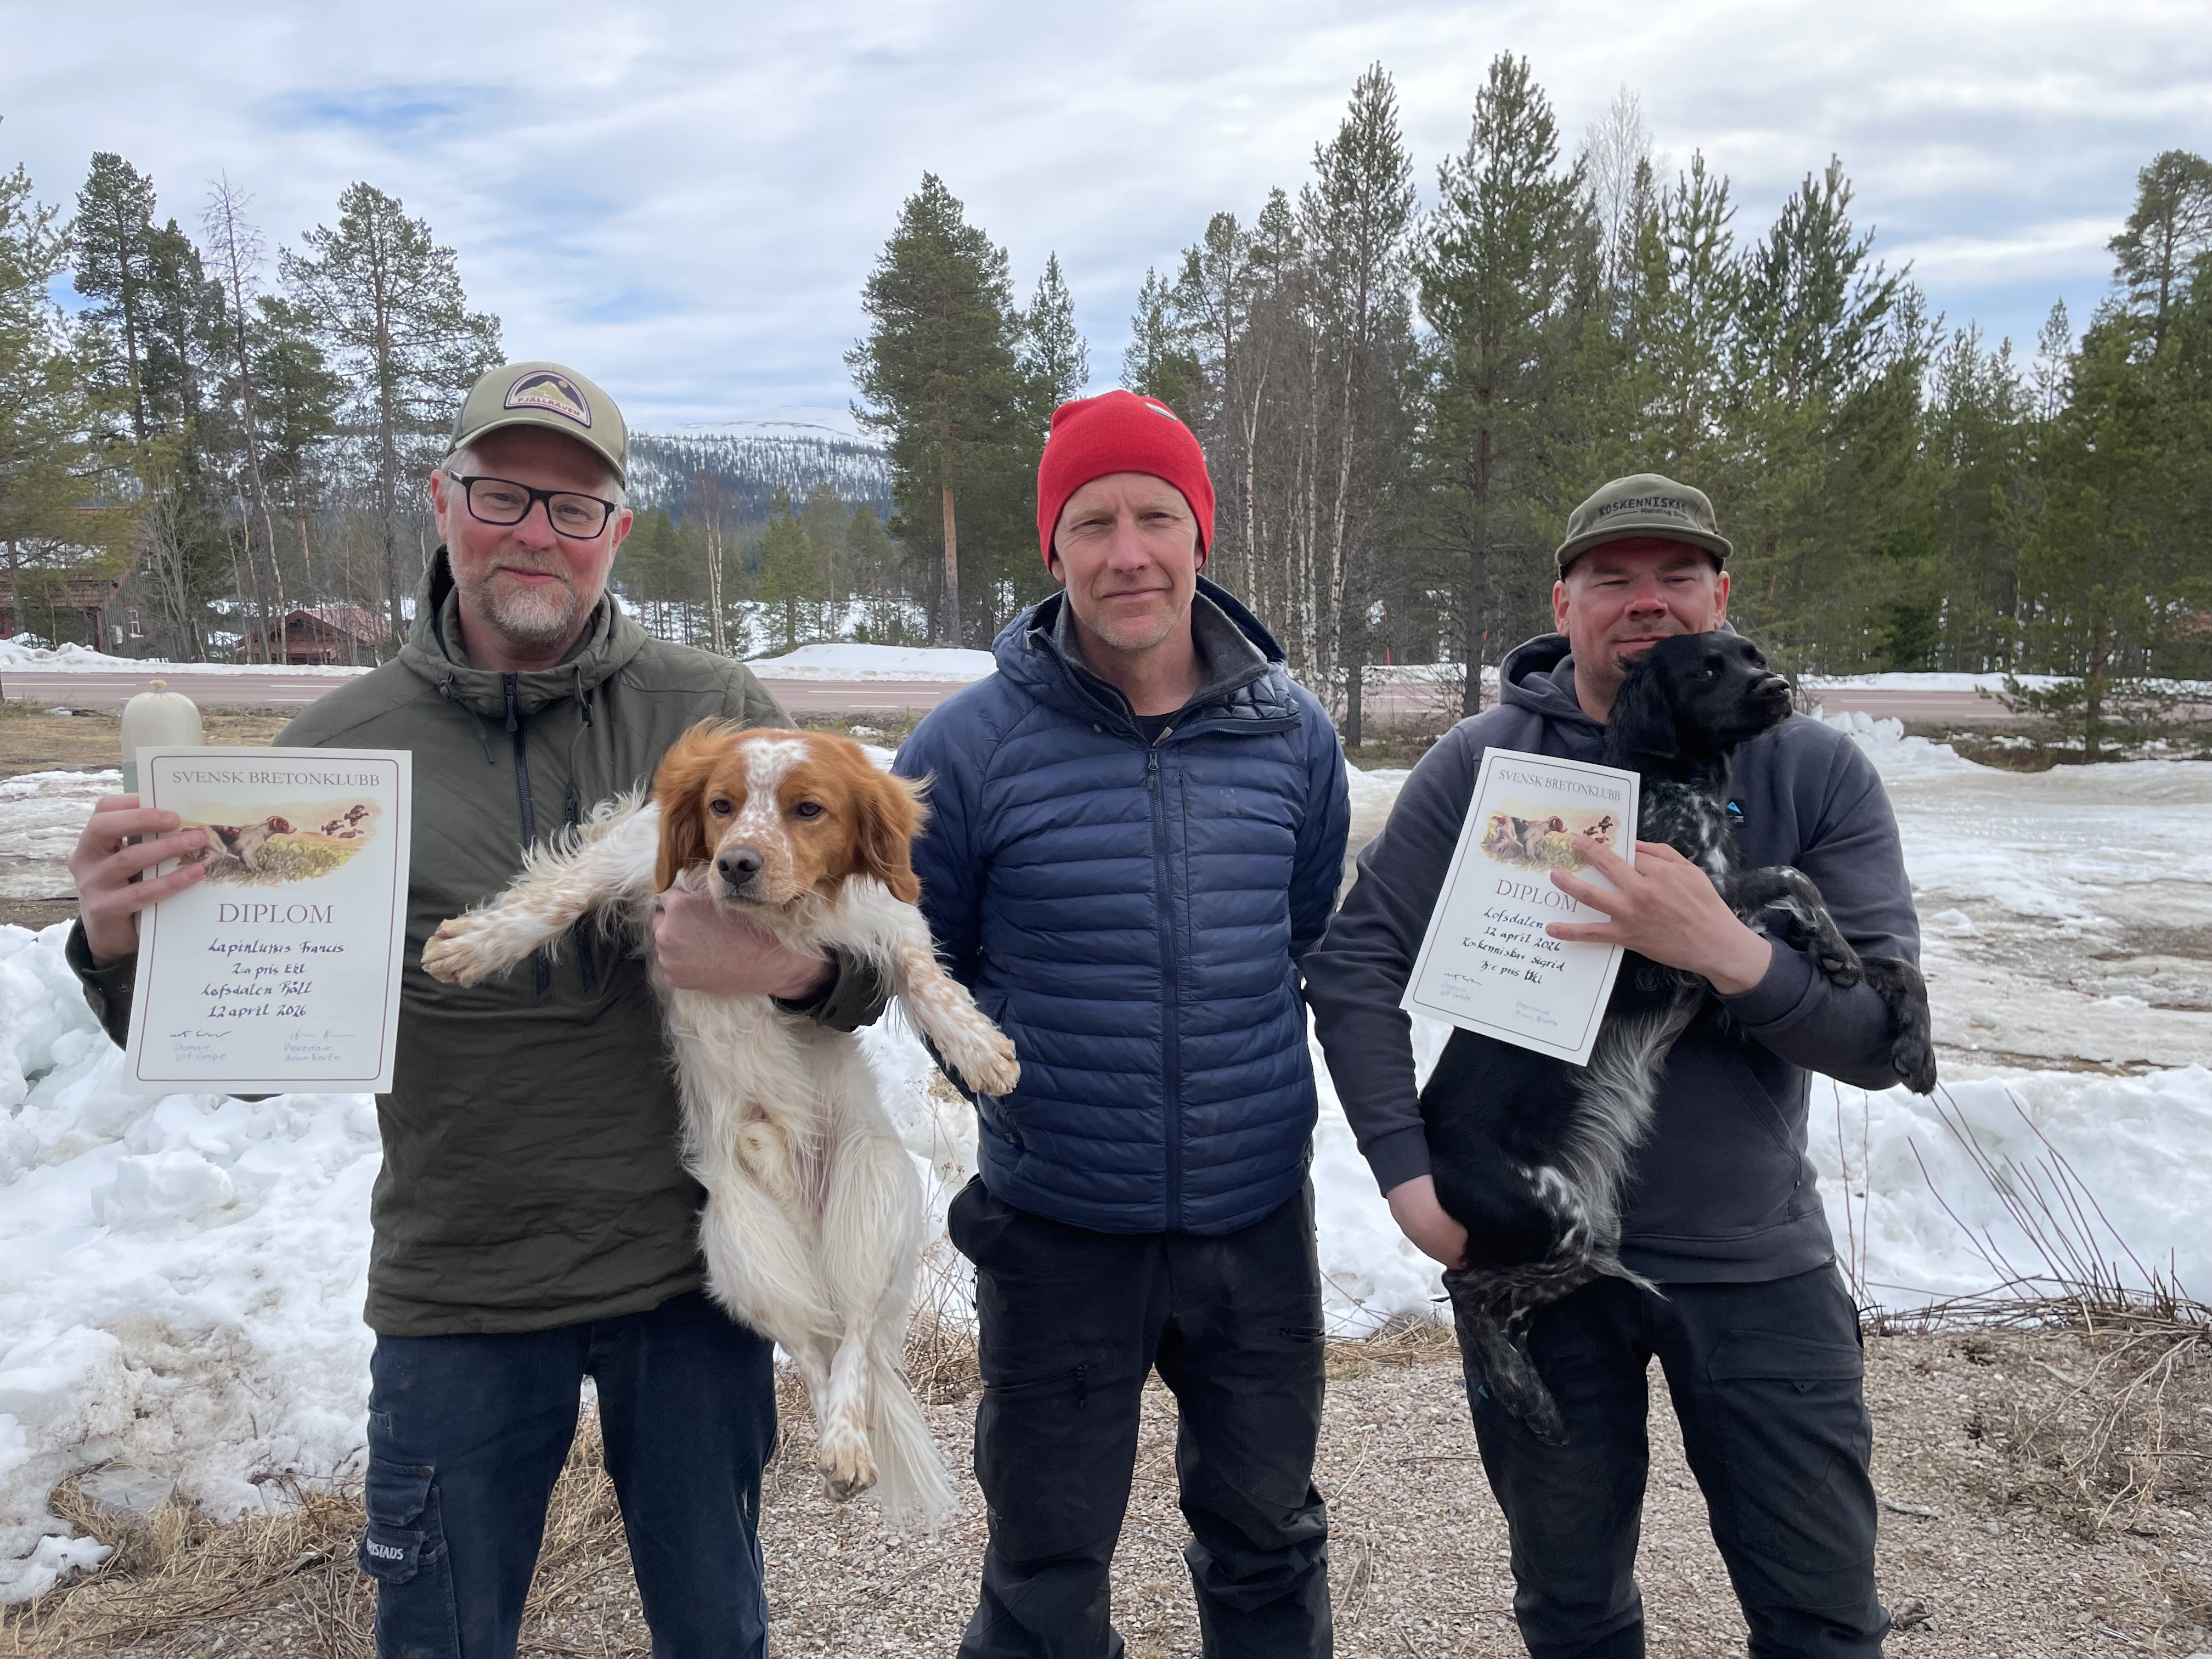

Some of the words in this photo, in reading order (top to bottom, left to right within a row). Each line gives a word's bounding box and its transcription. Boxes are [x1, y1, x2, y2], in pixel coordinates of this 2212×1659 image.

[518, 397, 580, 416] FJÄLLRÄVEN
[173, 771, 244, 783] SVENSK
[249, 772, 380, 786] BRETONKLUBB
[1499, 770, 1543, 787] SVENSK
[1545, 777, 1621, 802] BRETONKLUBB
[1494, 878, 1579, 913] DIPLOM
[217, 904, 334, 924] DIPLOM
[1483, 907, 1544, 928] Lofsdalen
[1483, 926, 1497, 937] 12
[1500, 933, 1532, 943] april
[1533, 938, 1561, 951] 2026
[254, 964, 278, 979] pris
[1500, 967, 1521, 977] pris
[1531, 956, 1565, 971] Sigrid
[200, 983, 273, 999] Lofsdalen
[207, 1006, 226, 1018] 12
[228, 1003, 269, 1018] april
[276, 1005, 306, 1018] 2026
